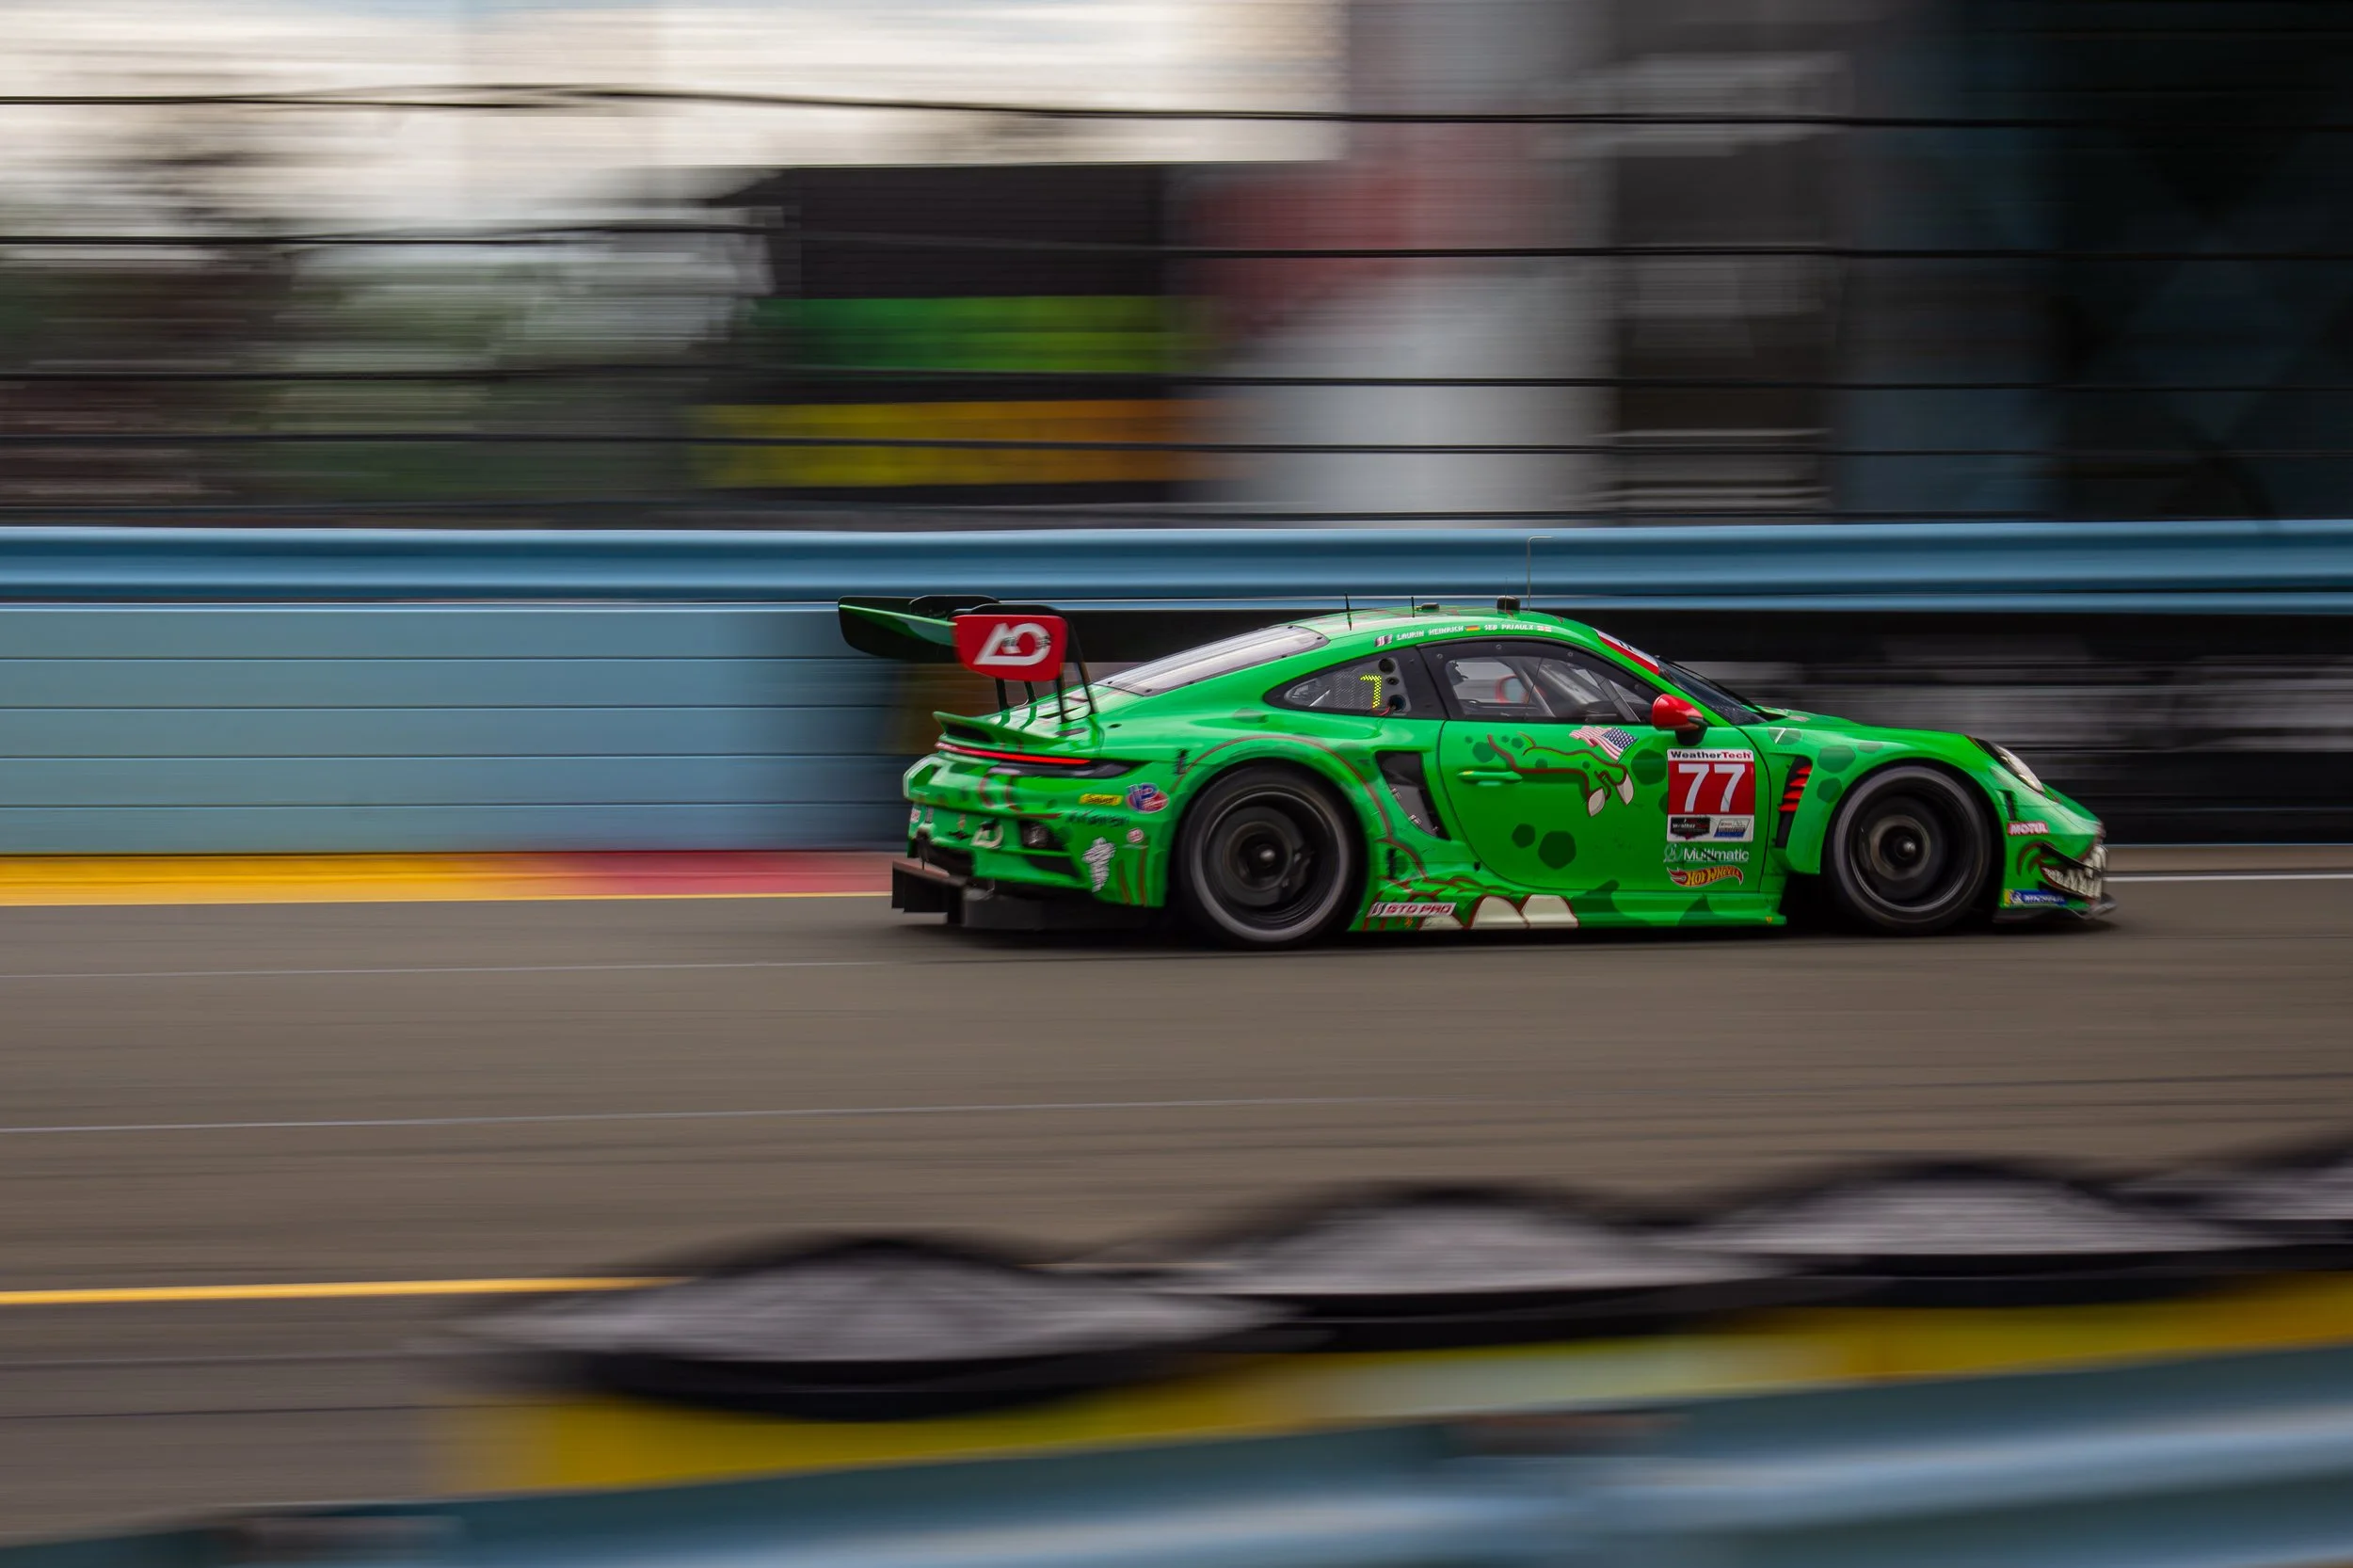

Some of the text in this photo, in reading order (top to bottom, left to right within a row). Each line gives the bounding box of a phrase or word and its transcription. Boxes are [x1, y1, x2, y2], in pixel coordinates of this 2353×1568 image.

[1397, 625, 1464, 641] LAURIN HEINRICH
[1678, 763, 1745, 812] 77
[2010, 822, 2049, 836] MOTUL
[1684, 848, 1749, 861] Multimatic
[1420, 904, 1452, 914] PRO
